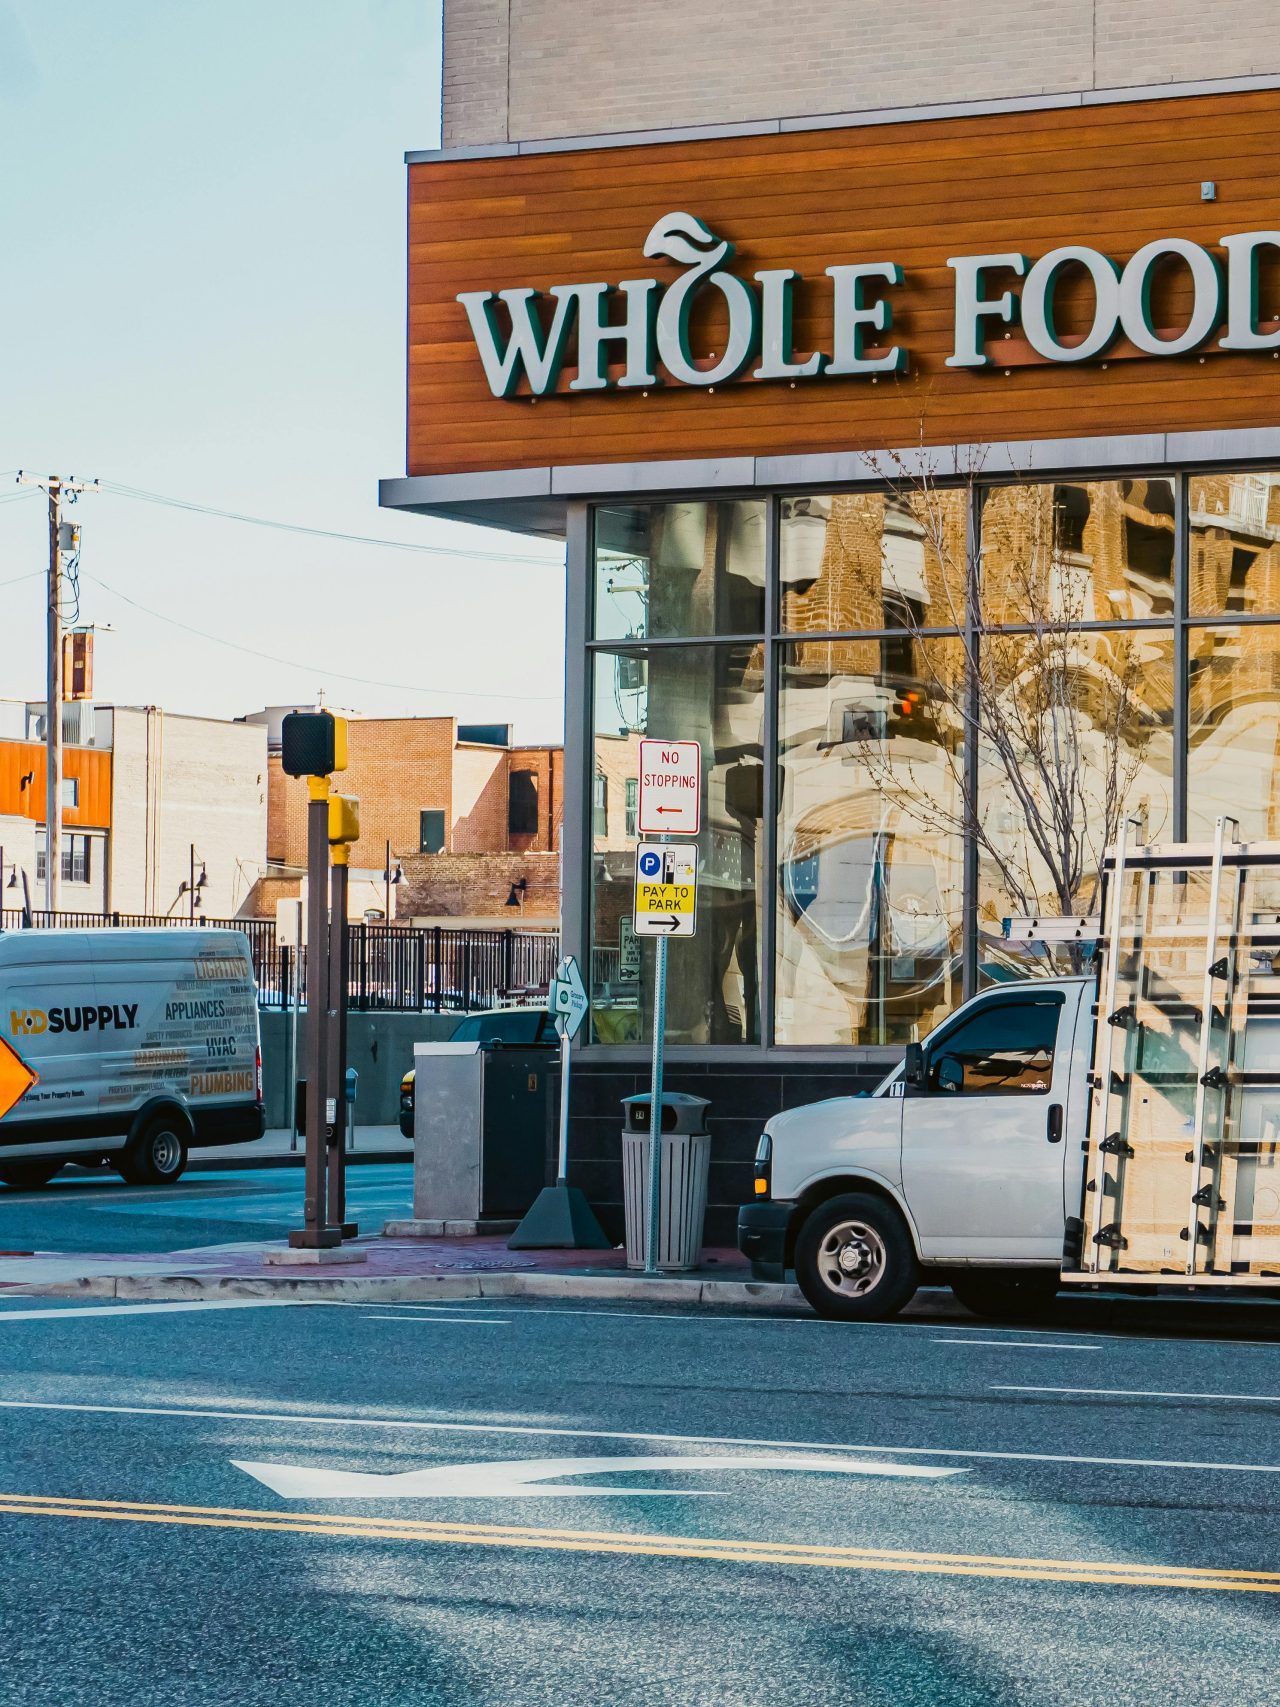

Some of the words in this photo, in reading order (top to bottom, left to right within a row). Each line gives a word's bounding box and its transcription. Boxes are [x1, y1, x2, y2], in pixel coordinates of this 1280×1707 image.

[456, 211, 909, 397] WHOLE
[661, 751, 680, 764] NO
[644, 774, 696, 789] STOPPING
[643, 886, 667, 898] PAY
[673, 887, 689, 899] TO
[648, 899, 682, 911] PARK
[624, 935, 640, 945] PAR
[194, 957, 248, 979] LIGHTING
[165, 1000, 225, 1021] APPLIANCES
[193, 1019, 232, 1031] HOSPITALITY
[205, 1036, 237, 1057] HVAC
[191, 1071, 254, 1096] PLUMBING
[890, 1082, 904, 1097] 11
